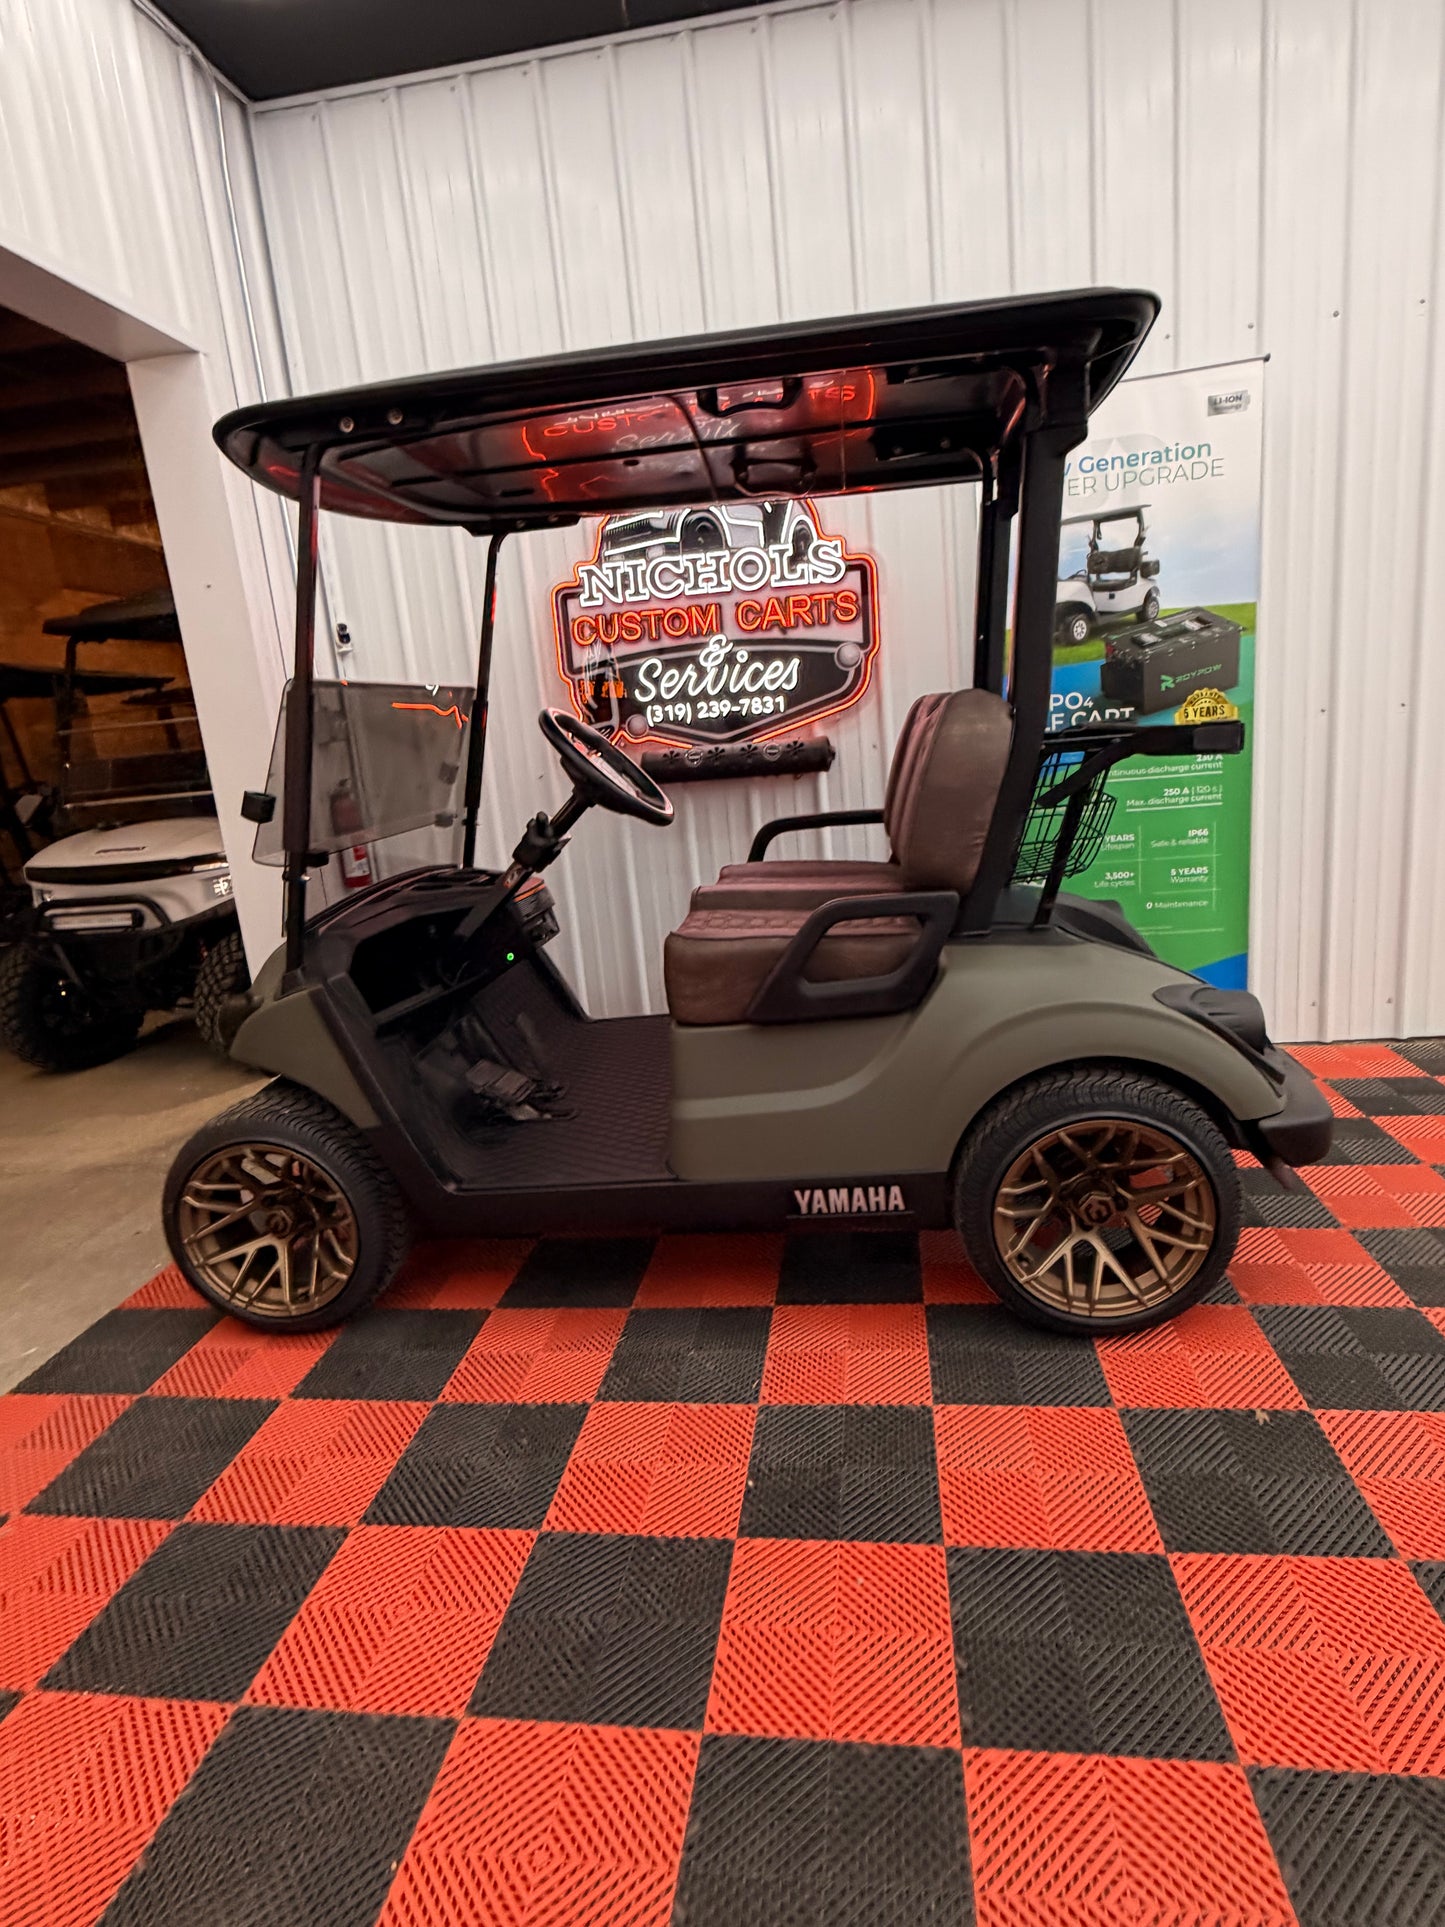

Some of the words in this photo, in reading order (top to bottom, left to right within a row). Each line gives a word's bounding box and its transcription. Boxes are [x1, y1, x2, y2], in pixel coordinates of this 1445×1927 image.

[1078, 442, 1212, 474] Generation
[1104, 458, 1225, 492] UPGRADE
[577, 540, 847, 608] NICHOLS
[572, 603, 720, 647] CUSTOM
[735, 590, 860, 631] CARTS
[699, 634, 733, 668] &
[634, 649, 800, 702] Services
[646, 701, 692, 727] (319)
[697, 695, 785, 719] 239-7831
[1184, 708, 1189, 719] 5
[1193, 705, 1225, 718] YEARS
[1108, 766, 1146, 775] ntinuous
[1147, 763, 1188, 773] discharge
[1190, 761, 1222, 770] current
[1147, 795, 1189, 805] discharge
[1190, 793, 1222, 802] current
[1105, 834, 1135, 842] YEARS
[1179, 866, 1208, 875] YEARS
[793, 1185, 906, 1214] YAMAHA
